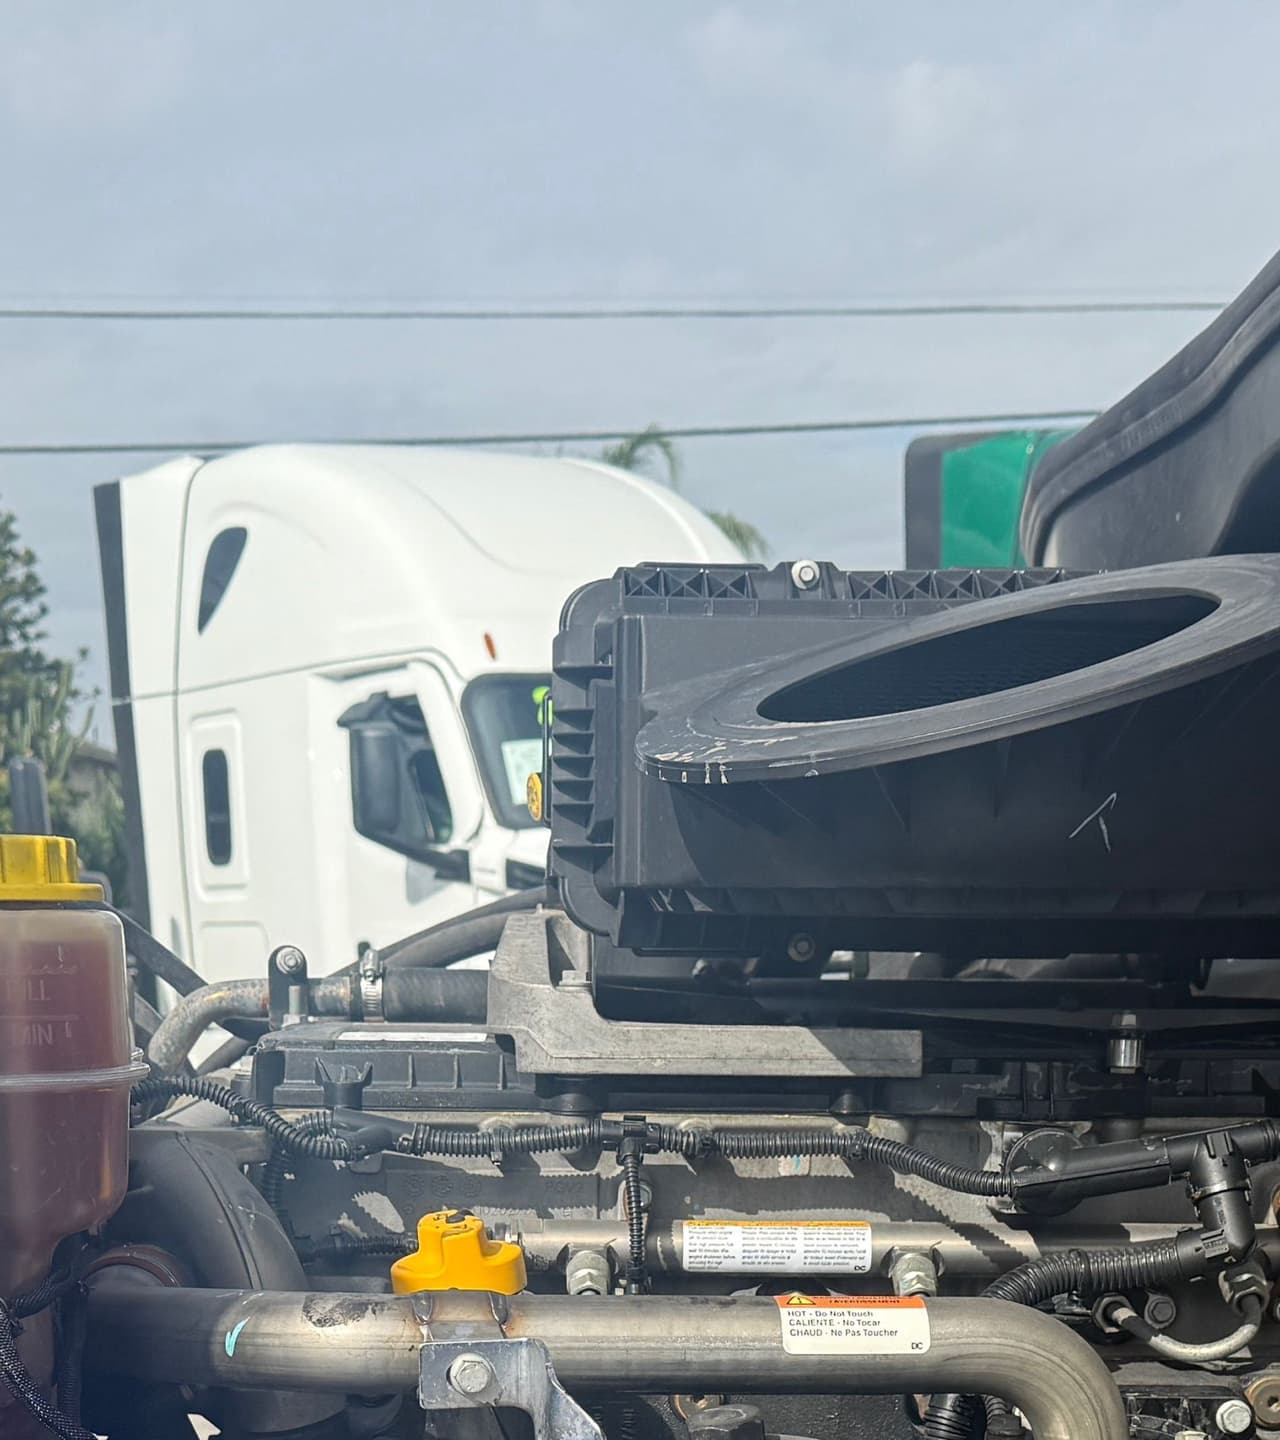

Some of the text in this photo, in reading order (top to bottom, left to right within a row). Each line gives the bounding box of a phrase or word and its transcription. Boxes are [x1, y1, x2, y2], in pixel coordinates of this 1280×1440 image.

[854, 1264, 866, 1272] DC
[787, 1310, 806, 1318] HOT
[830, 1310, 845, 1318] Not
[847, 1310, 874, 1318] Touch
[789, 1318, 881, 1327] CALIENTE No Tocar
[789, 1328, 898, 1337] CHAUD Ne Pas Toucher
[911, 1342, 923, 1350] DC
